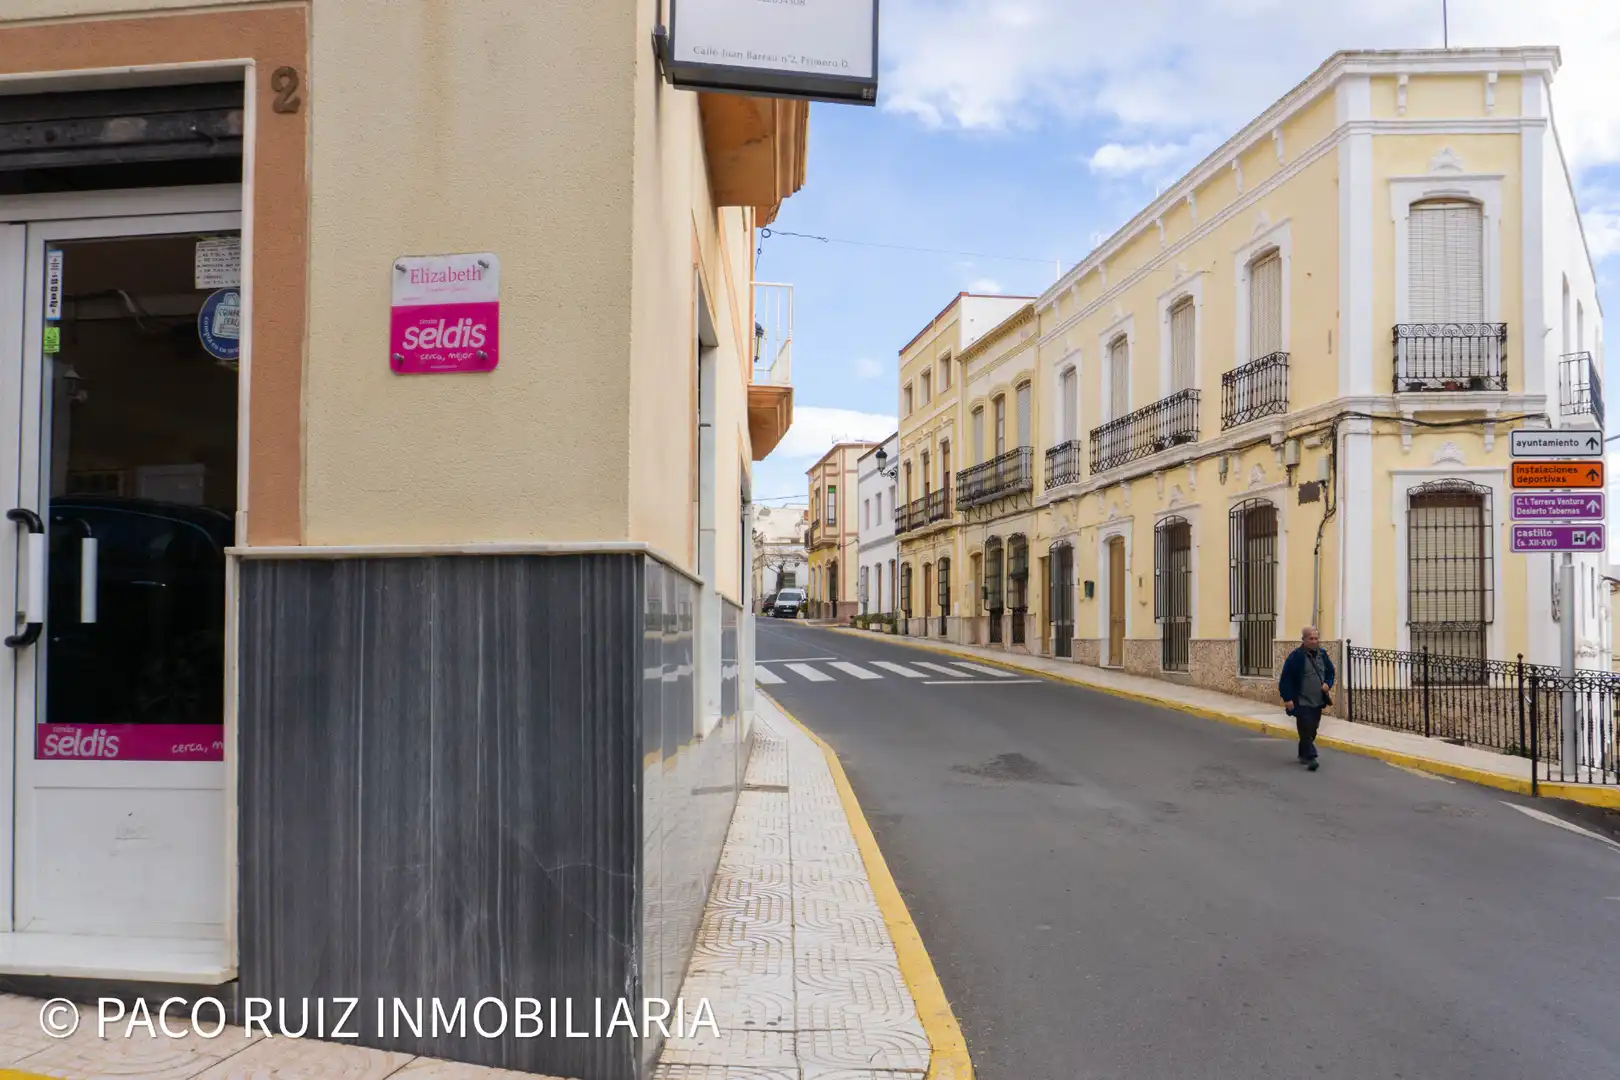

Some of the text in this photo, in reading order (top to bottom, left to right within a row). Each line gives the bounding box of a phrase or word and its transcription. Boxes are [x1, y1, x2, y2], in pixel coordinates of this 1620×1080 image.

[693, 45, 718, 56] Calle
[721, 49, 743, 60] Juan
[801, 56, 838, 68] Primero
[271, 66, 301, 114] 2
[410, 265, 482, 284] Elizabeth
[402, 318, 487, 350] seldis
[448, 351, 474, 361] mejor
[1516, 439, 1579, 448] ayuntamiento
[1516, 466, 1578, 474] instalaciones
[1516, 475, 1567, 484] deportivas
[1516, 507, 1580, 515] Desierto Tabernas
[1516, 528, 1553, 537] castillo
[43, 728, 120, 758] seldis
[172, 743, 208, 753] cerca,
